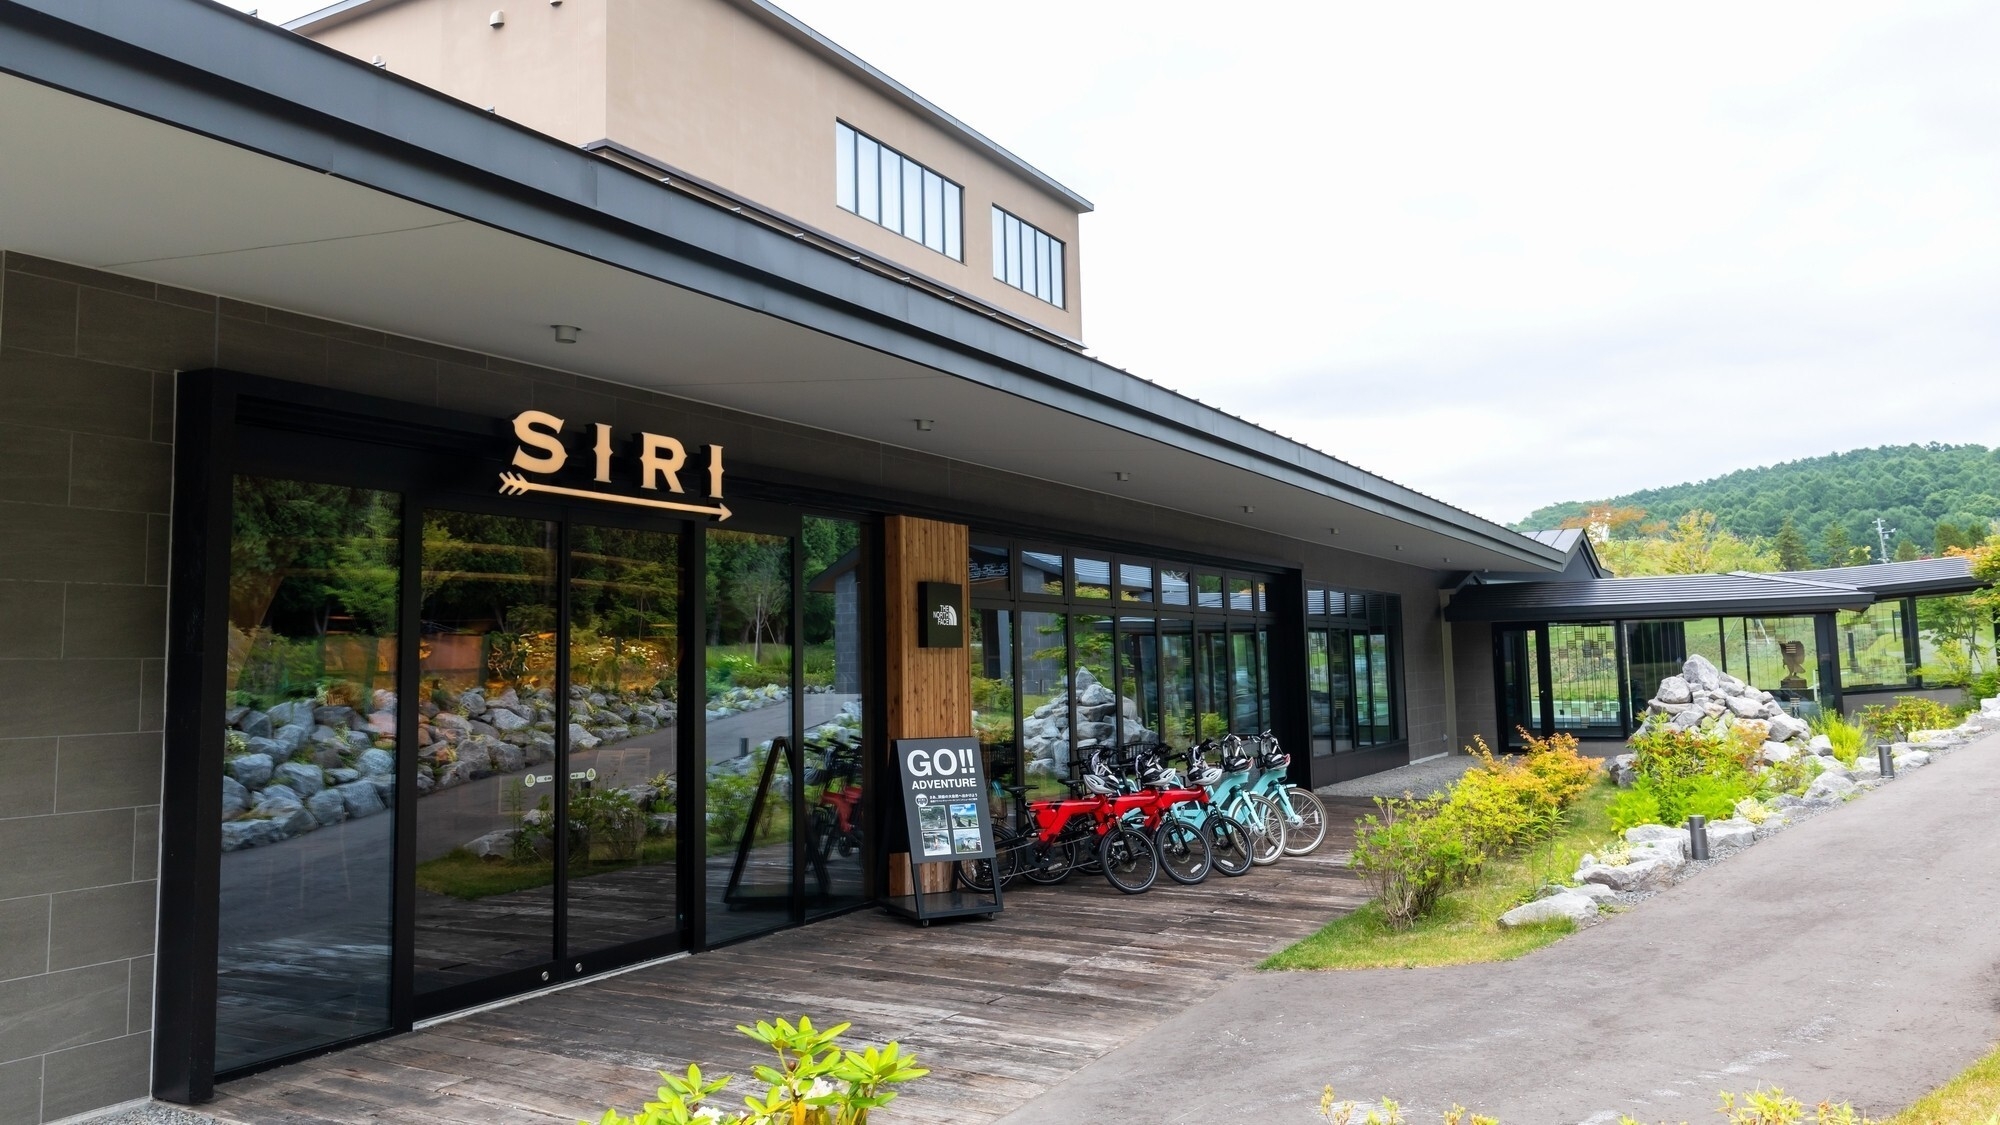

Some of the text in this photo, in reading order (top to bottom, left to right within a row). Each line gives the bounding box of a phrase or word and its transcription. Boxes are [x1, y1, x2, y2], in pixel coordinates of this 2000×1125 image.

[511, 410, 725, 499] SIRI
[939, 604, 949, 612] THE
[932, 611, 949, 619] NORTH
[937, 618, 949, 626] FACE
[907, 748, 975, 777] GO!!
[912, 778, 977, 790] ADVENTURE
